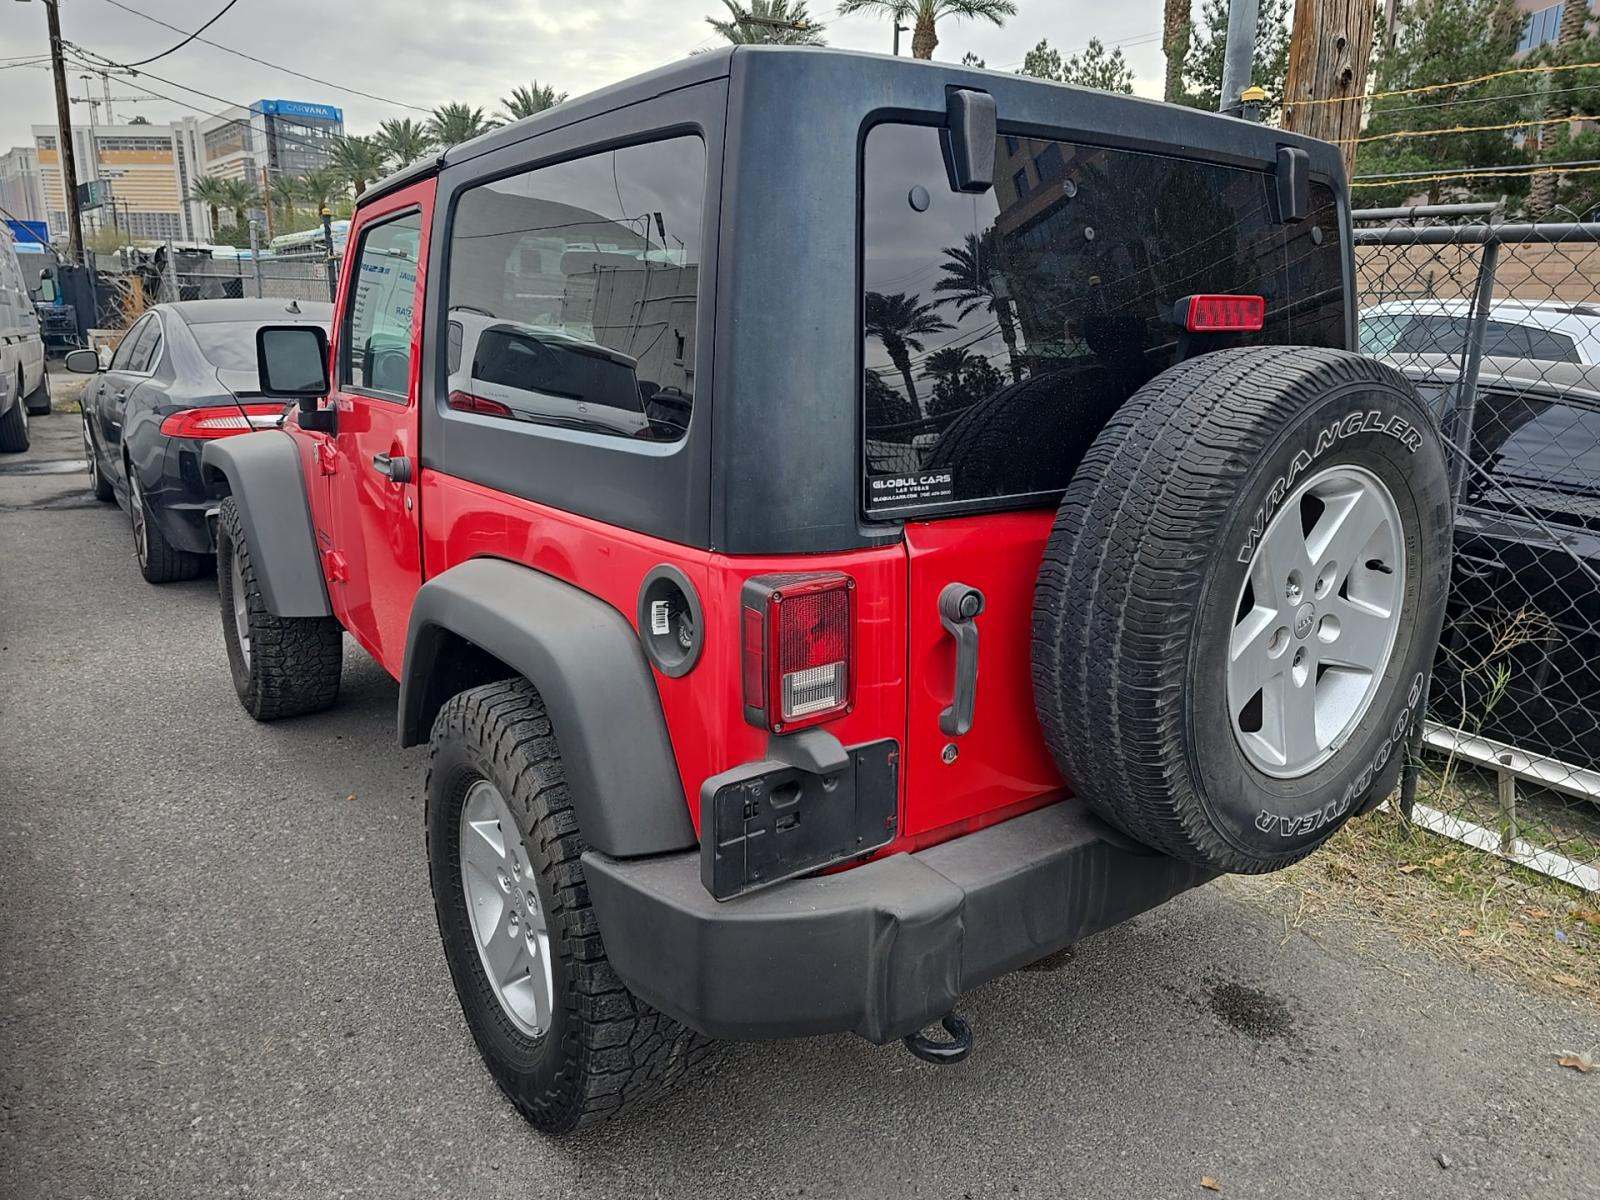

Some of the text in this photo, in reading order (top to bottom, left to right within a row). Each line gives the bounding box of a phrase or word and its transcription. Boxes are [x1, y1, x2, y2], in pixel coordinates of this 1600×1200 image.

[287, 104, 328, 115] CARVANA
[873, 475, 951, 488] GLOBUL CARS
[1238, 411, 1424, 563] WRANGLER
